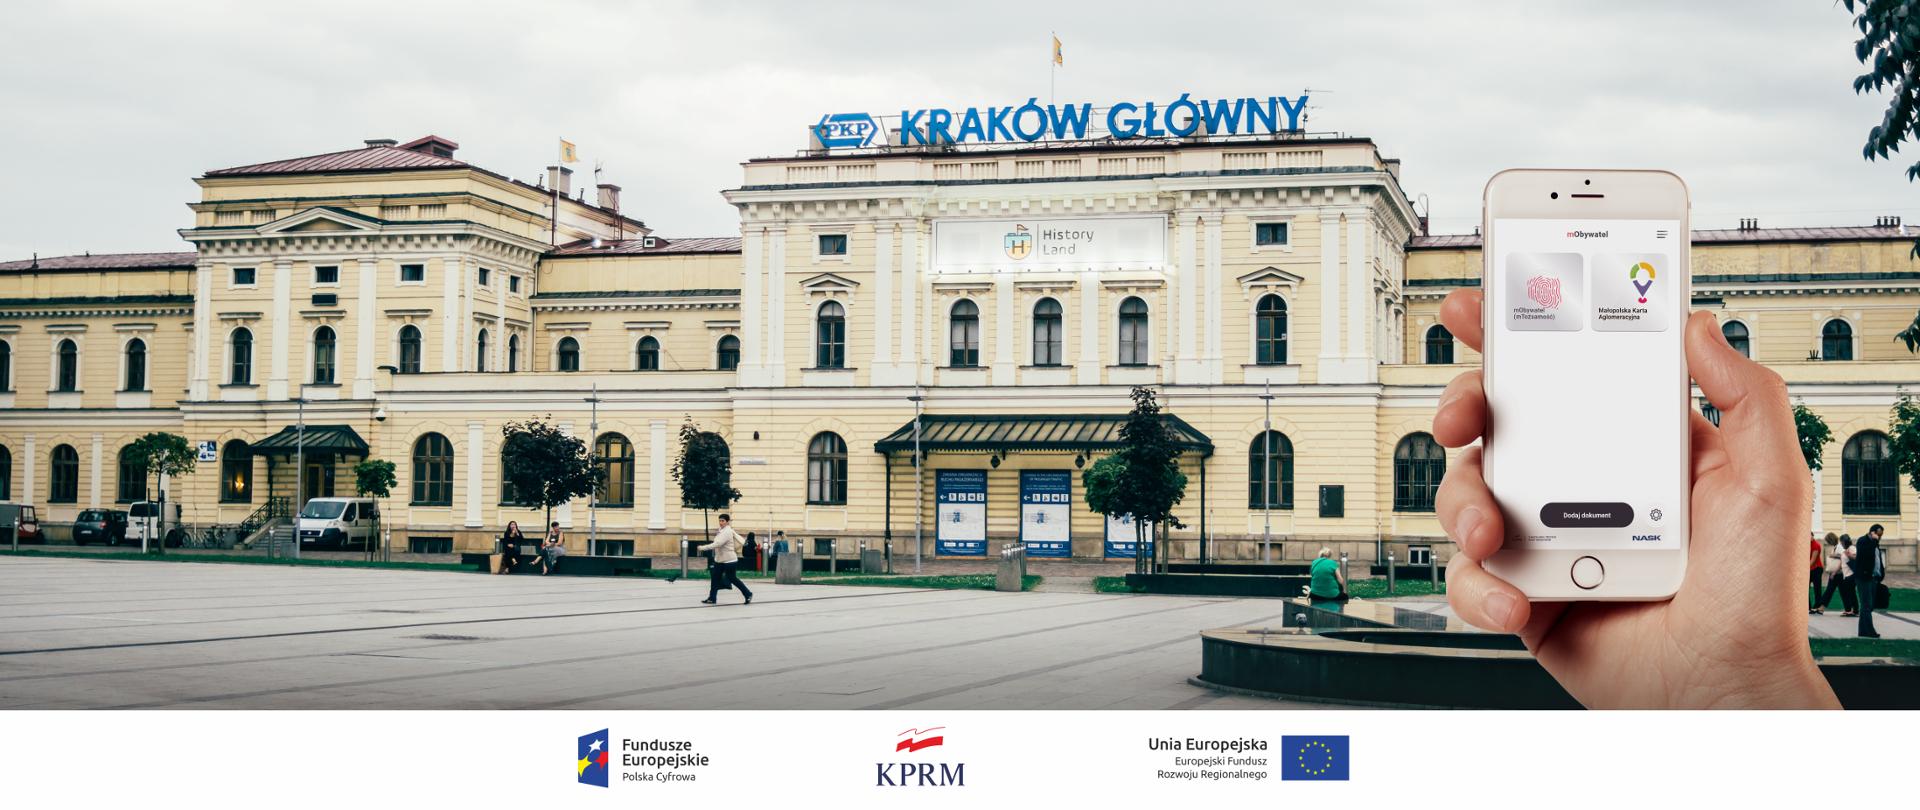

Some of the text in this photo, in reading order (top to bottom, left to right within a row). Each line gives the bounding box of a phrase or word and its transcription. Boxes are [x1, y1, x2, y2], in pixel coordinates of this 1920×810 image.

[900, 93, 1309, 145] KRAKÓW GŁÓWNY
[825, 123, 870, 137] PKP
[1043, 228, 1094, 246] History
[1567, 230, 1609, 239] mObywatel
[1042, 243, 1077, 256] Land
[1513, 307, 1546, 315] mObywatel
[1598, 307, 1632, 315] Małopolska
[1563, 512, 1581, 520] Dodaj
